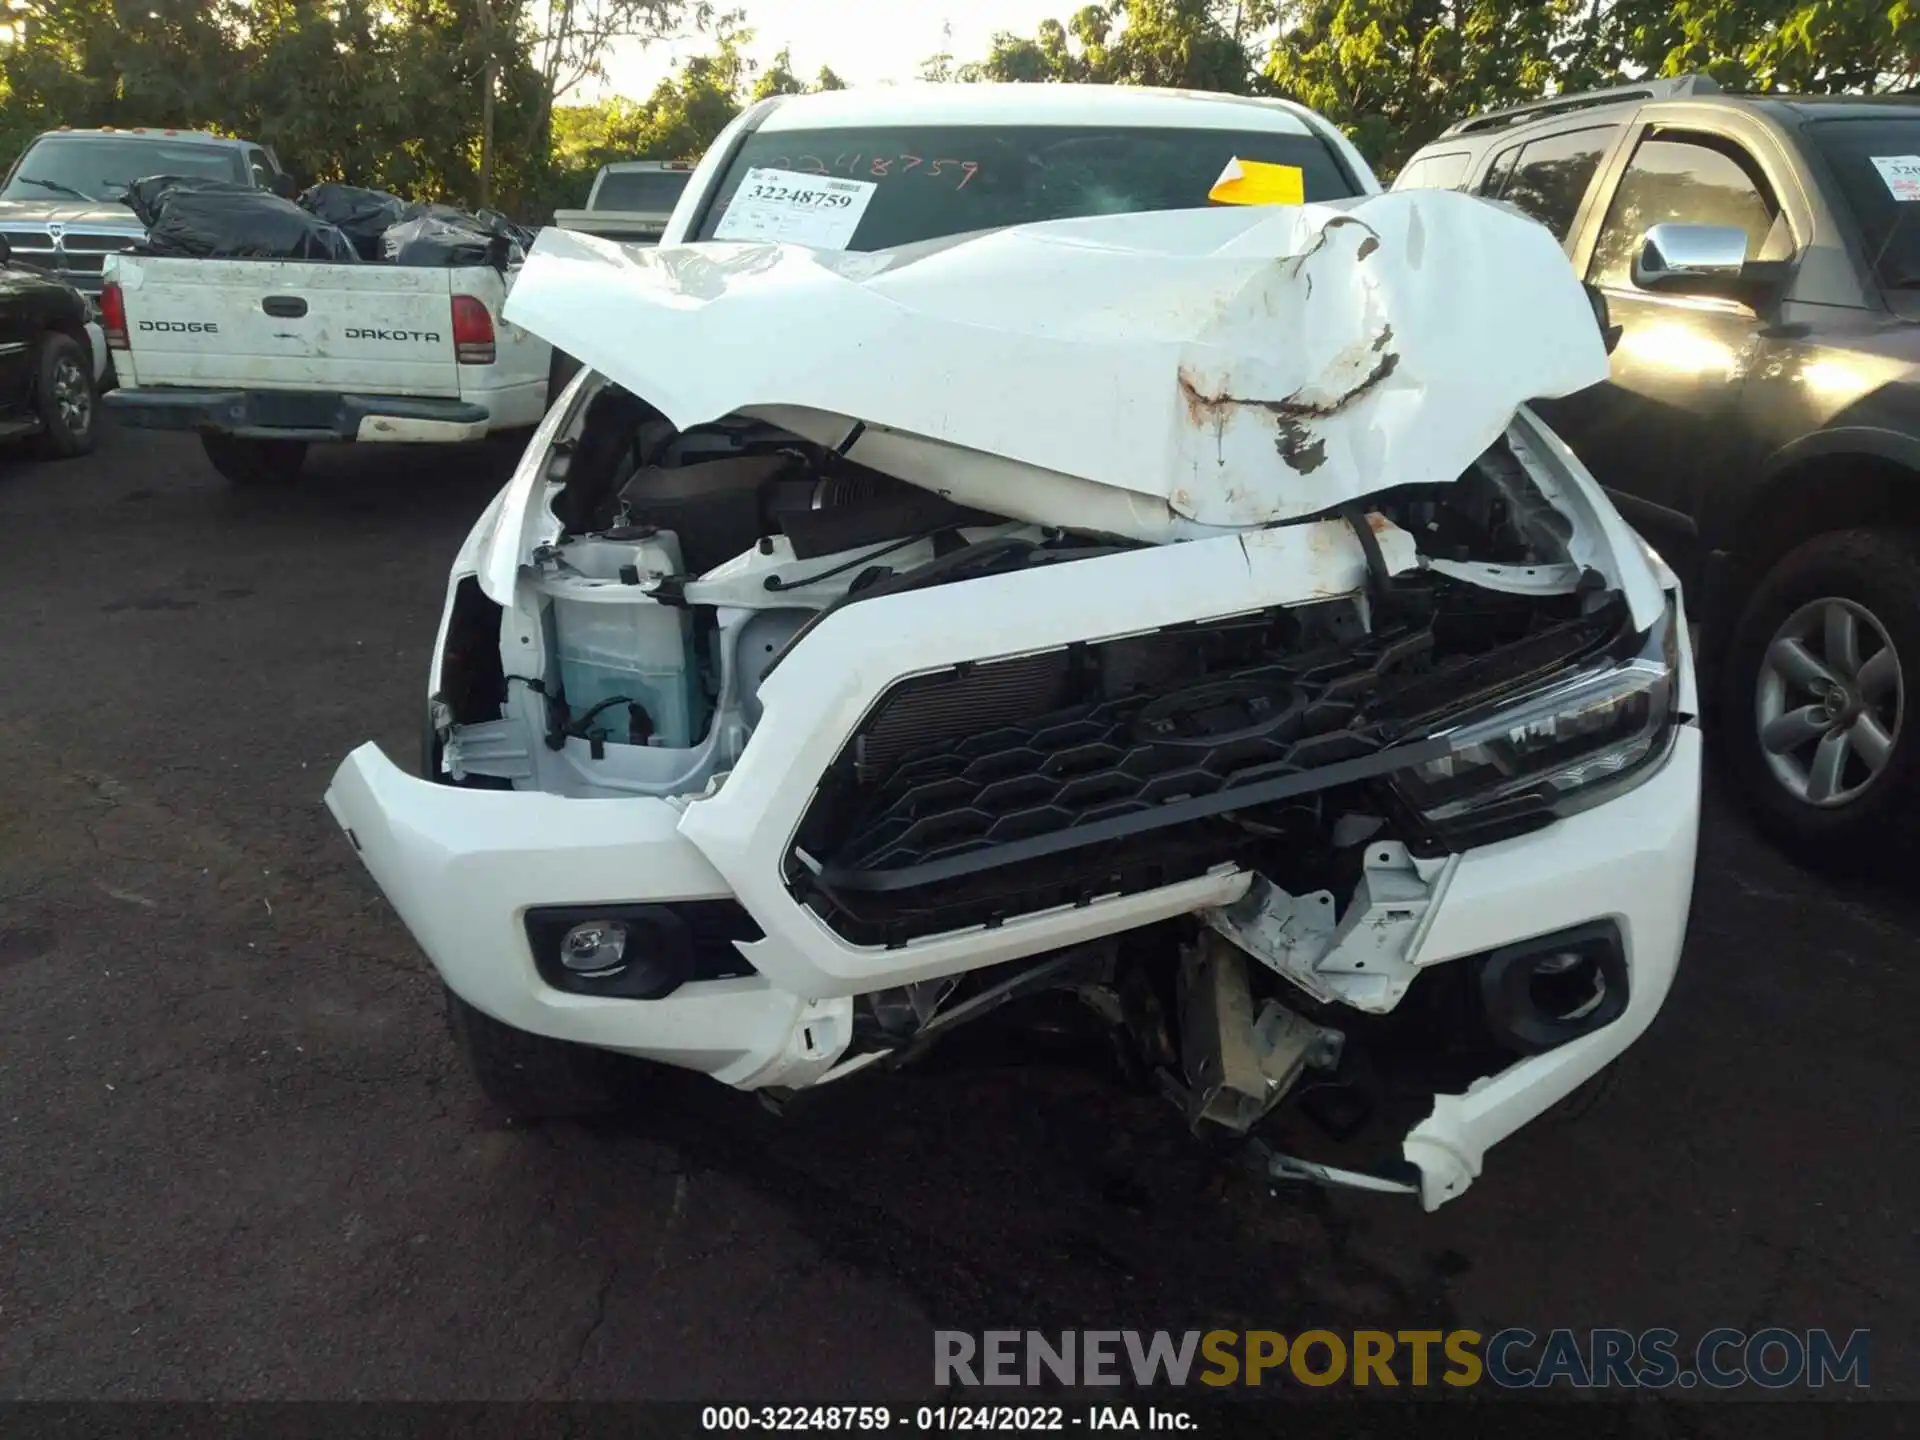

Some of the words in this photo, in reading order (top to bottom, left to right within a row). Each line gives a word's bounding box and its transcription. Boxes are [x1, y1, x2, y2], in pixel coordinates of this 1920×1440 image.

[753, 155, 979, 190] 2248759
[748, 184, 853, 209] 32248759
[139, 320, 218, 333] DODGE
[345, 328, 441, 342] DAKOTA
